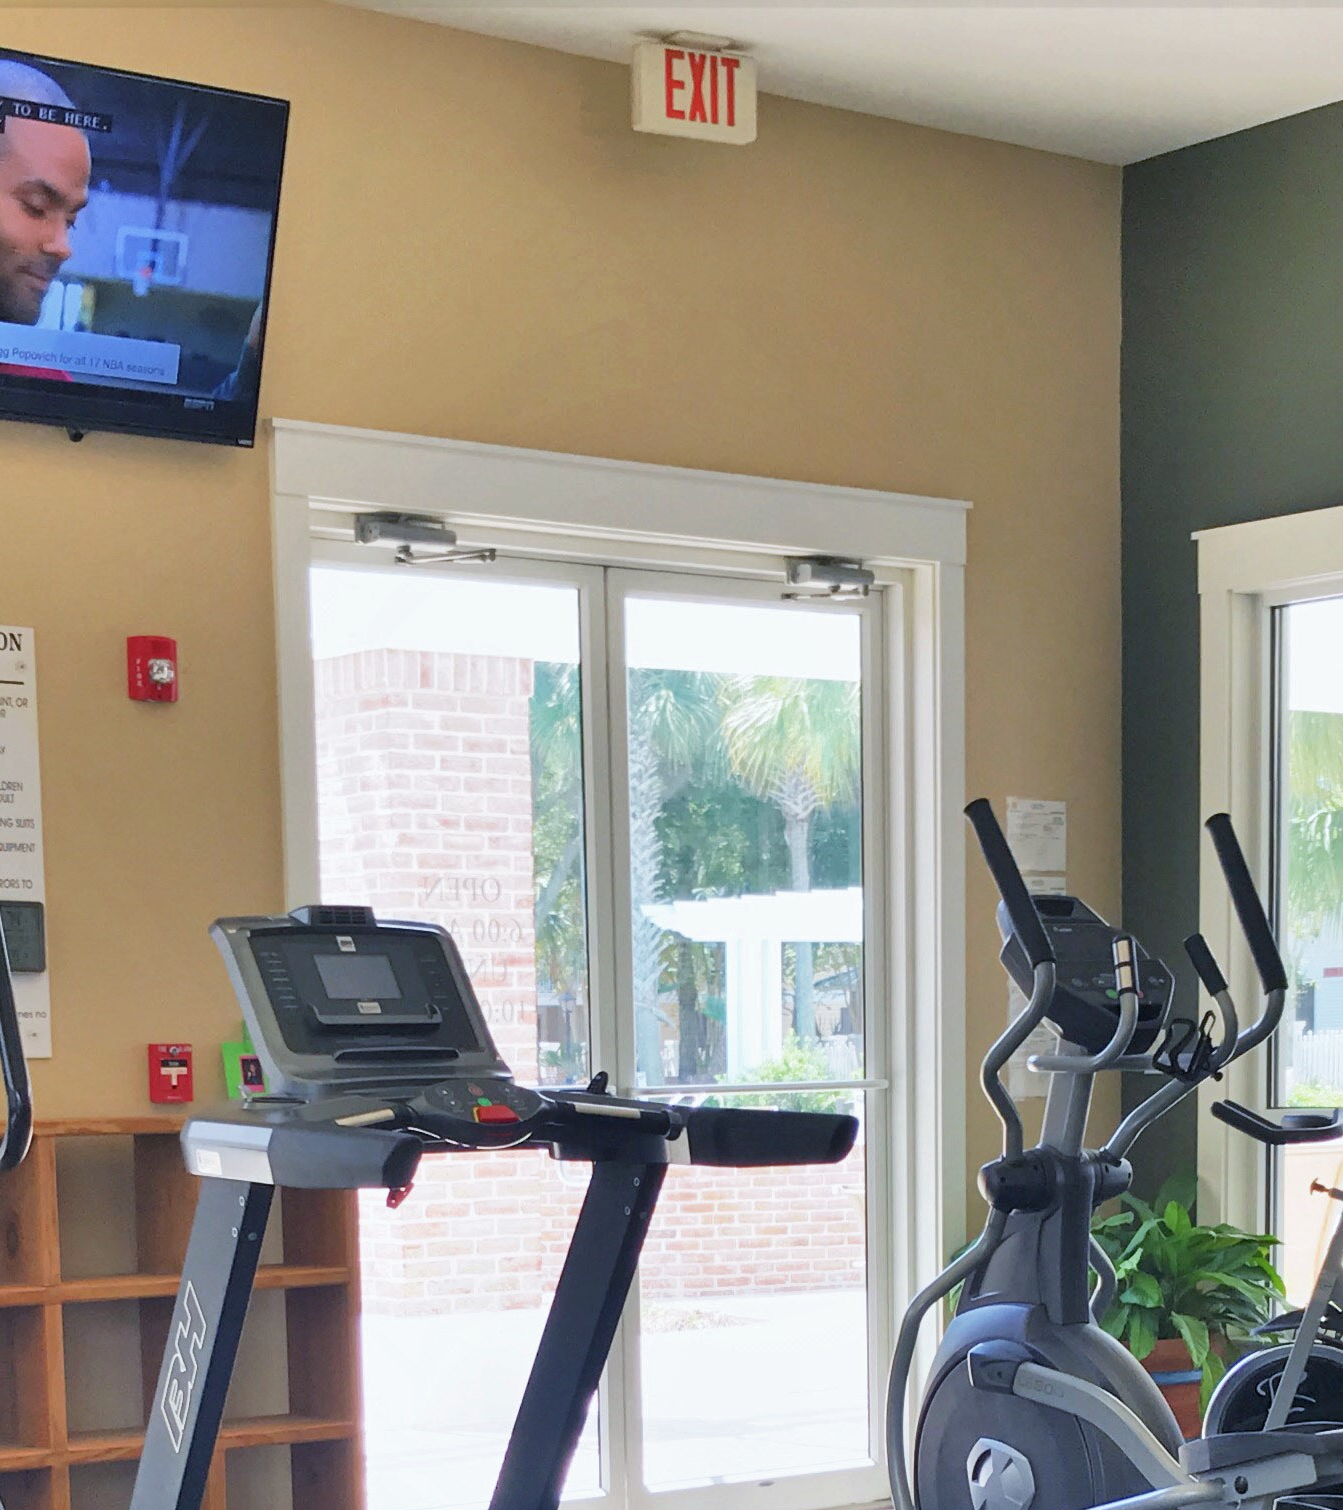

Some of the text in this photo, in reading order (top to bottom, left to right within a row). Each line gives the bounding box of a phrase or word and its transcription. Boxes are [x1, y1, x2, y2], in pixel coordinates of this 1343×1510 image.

[664, 48, 740, 127] EXIT
[13, 102, 32, 116] TO
[39, 108, 57, 121] BE
[64, 112, 108, 130] HERE.
[12, 347, 57, 362] Popovich
[59, 353, 72, 364] for
[74, 355, 87, 366] all
[90, 357, 101, 368] 17
[102, 359, 124, 371] NBA
[127, 364, 166, 376] seasons
[15, 697, 28, 708] OR
[15, 818, 35, 829] SUITS
[22, 879, 33, 889] TO
[35, 1011, 46, 1019] no
